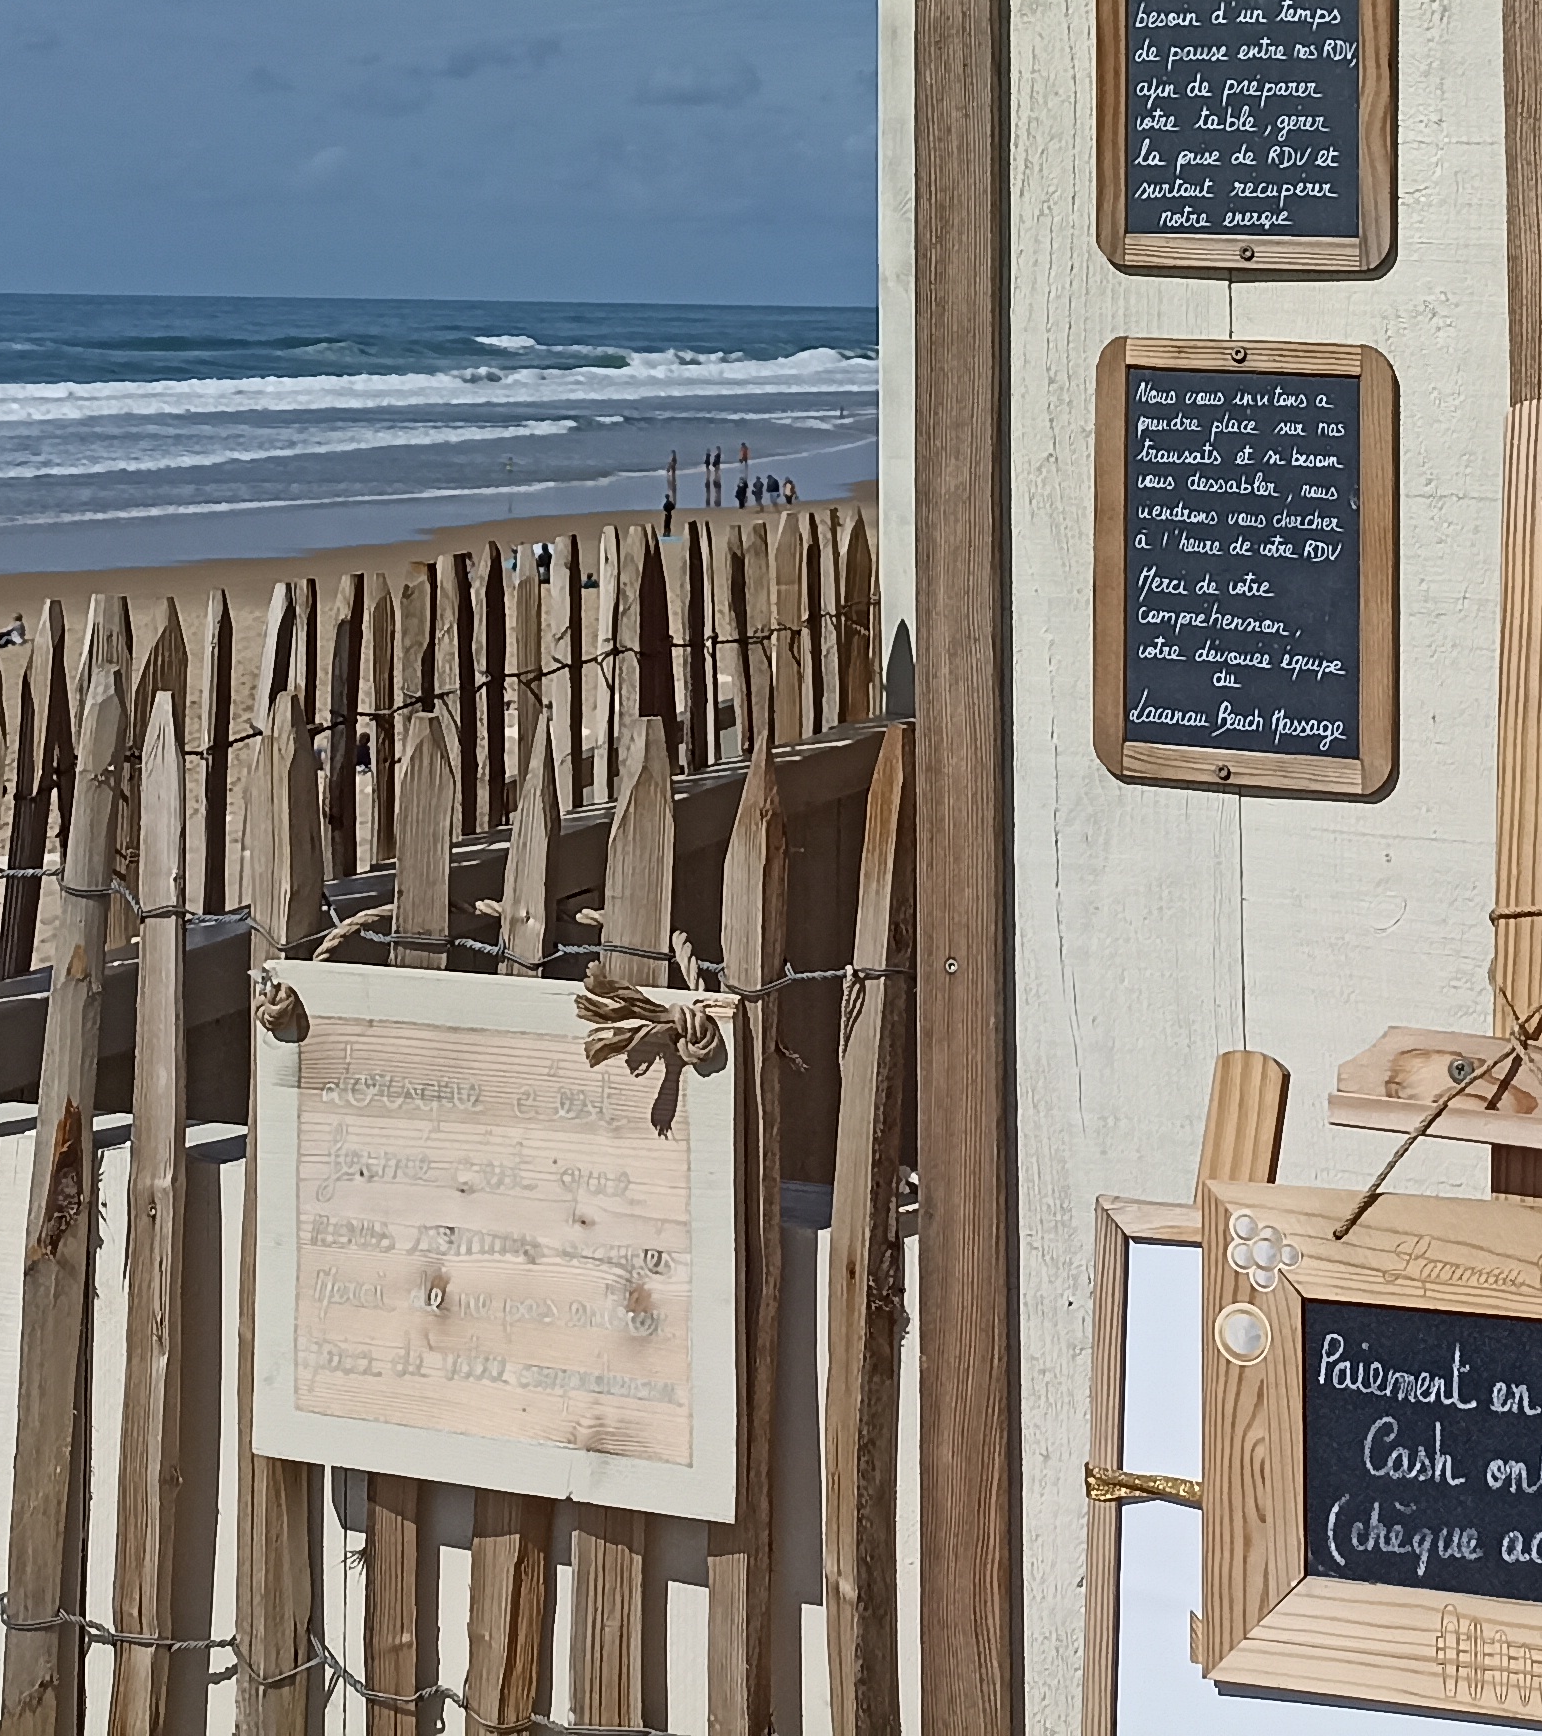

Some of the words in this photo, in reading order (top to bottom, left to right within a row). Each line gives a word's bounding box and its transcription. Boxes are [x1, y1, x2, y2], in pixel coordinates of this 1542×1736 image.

[1135, 2, 1201, 27] besoin
[1211, 1, 1268, 24] d'un
[1275, 0, 1341, 31] temps
[1135, 38, 1160, 62] de
[1167, 45, 1229, 71] pause
[1237, 37, 1288, 59] entre
[1293, 44, 1318, 59] nos
[1136, 76, 1180, 109] afin
[1186, 72, 1212, 96] de
[1221, 74, 1323, 109] préparer
[1136, 108, 1180, 131] votre
[1276, 105, 1330, 141] gérer
[1134, 138, 1167, 165] la
[1231, 143, 1257, 164] de
[1267, 146, 1312, 168] RDV
[1314, 147, 1339, 167] et
[1134, 178, 1215, 199] surtout
[1229, 172, 1338, 209] récupérer
[1159, 205, 1211, 227] notre
[1223, 203, 1293, 229] énergie
[1135, 381, 1176, 405] Nous
[1185, 391, 1224, 405] vous
[1232, 386, 1307, 408] invitons
[1137, 412, 1202, 440] prendre
[1211, 412, 1260, 443] place
[1274, 422, 1307, 436] sur
[1318, 422, 1345, 437] nos
[1135, 438, 1221, 464] transats
[1234, 445, 1255, 465] et
[1263, 446, 1287, 464] si
[1291, 445, 1344, 469] besoin
[1137, 474, 1175, 490] vous
[1300, 484, 1338, 500] nous
[1138, 500, 1218, 525] viendrons
[1228, 512, 1266, 527] vous
[1272, 508, 1344, 532] chercher
[1135, 529, 1153, 549] à
[1161, 528, 1223, 555] l'heure
[1229, 535, 1253, 556] de
[1259, 535, 1299, 559] votre
[1303, 540, 1342, 562] RDV
[1138, 565, 1189, 602] Merci
[1195, 572, 1220, 594] de
[1228, 572, 1275, 596] votre
[1138, 635, 1187, 660] votre
[1194, 639, 1271, 668] dévouée
[1280, 644, 1346, 681] équipe
[1212, 668, 1242, 687] du
[1129, 688, 1210, 726] Lacanau
[1211, 701, 1264, 737] Beach
[1271, 708, 1347, 750] Massage
[314, 1266, 395, 1321] Merci
[409, 1270, 449, 1317] de
[460, 1292, 493, 1320] ne
[502, 1297, 558, 1342] pas
[1318, 1333, 1477, 1409] Paiement
[1490, 1381, 1542, 1415] en
[1363, 1415, 1466, 1486] Cash
